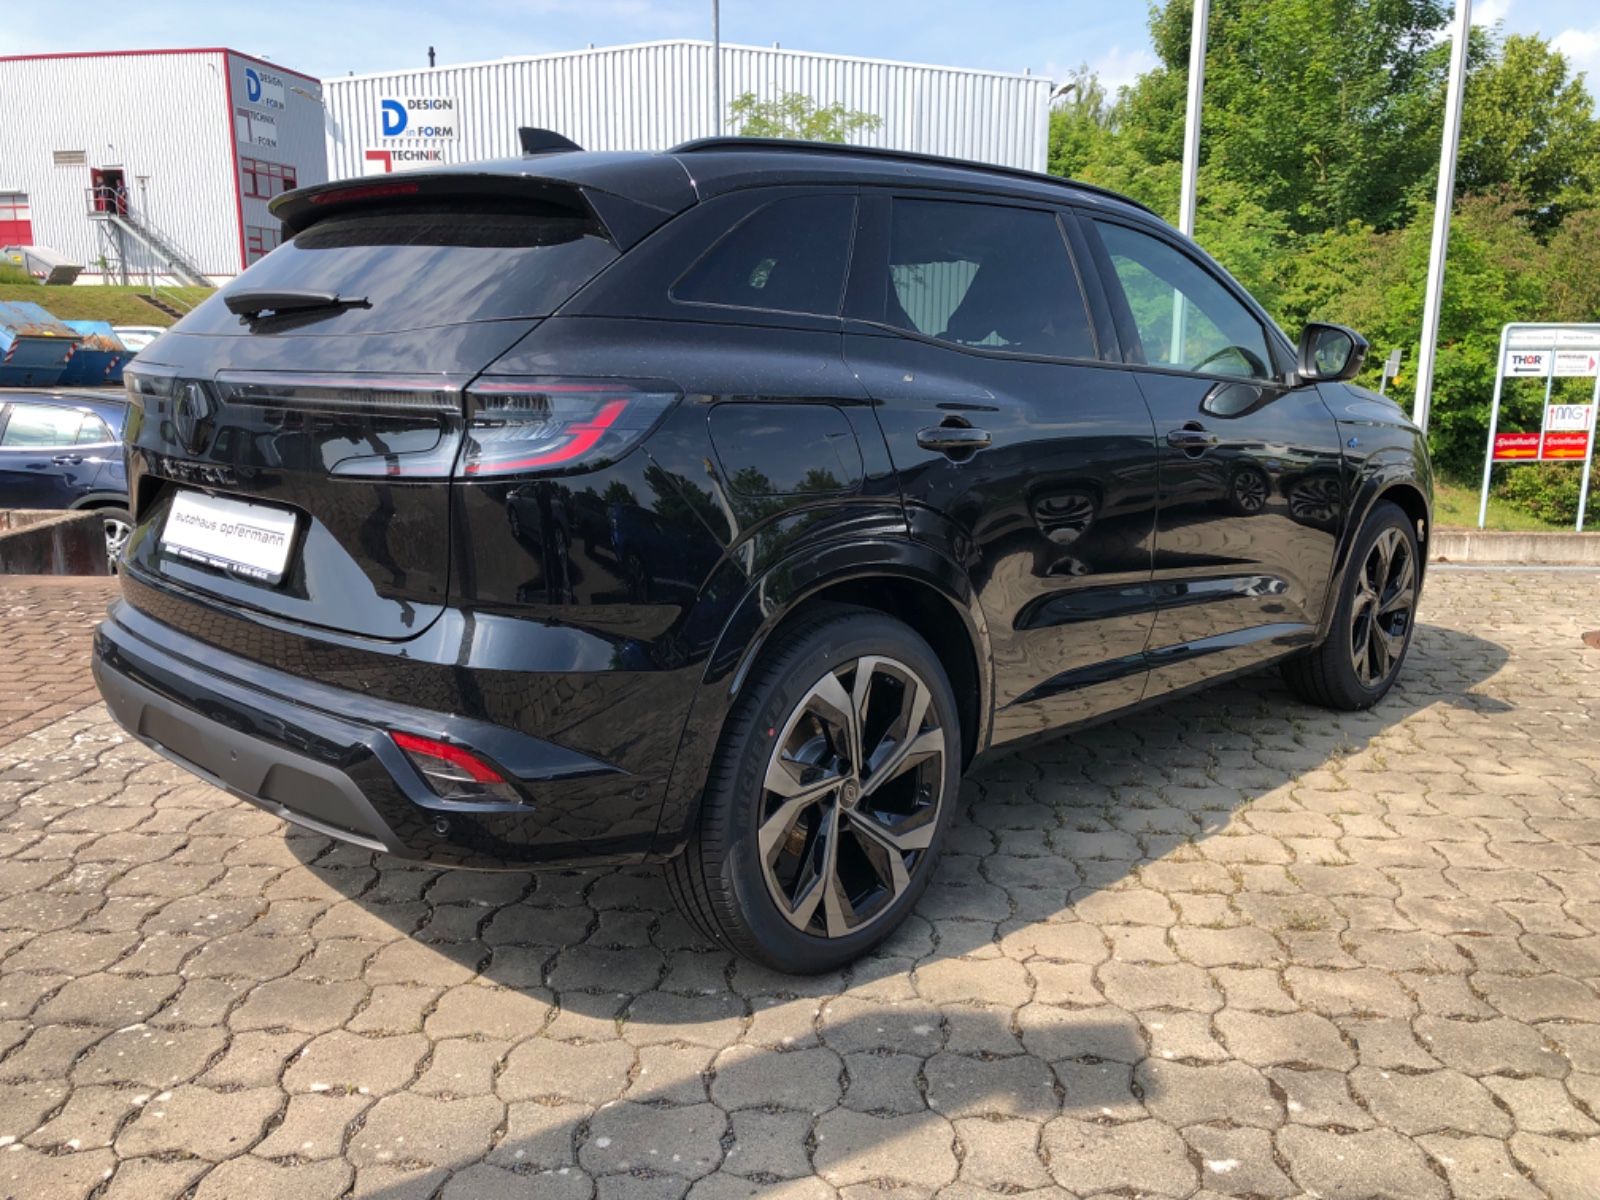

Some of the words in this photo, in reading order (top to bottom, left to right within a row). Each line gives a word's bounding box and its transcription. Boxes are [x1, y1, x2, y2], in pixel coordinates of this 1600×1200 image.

[407, 99, 453, 110] DESIGN
[381, 99, 408, 136] D
[418, 126, 453, 137] FORM
[391, 150, 442, 161] TECHNIK
[1512, 355, 1542, 365] THOR
